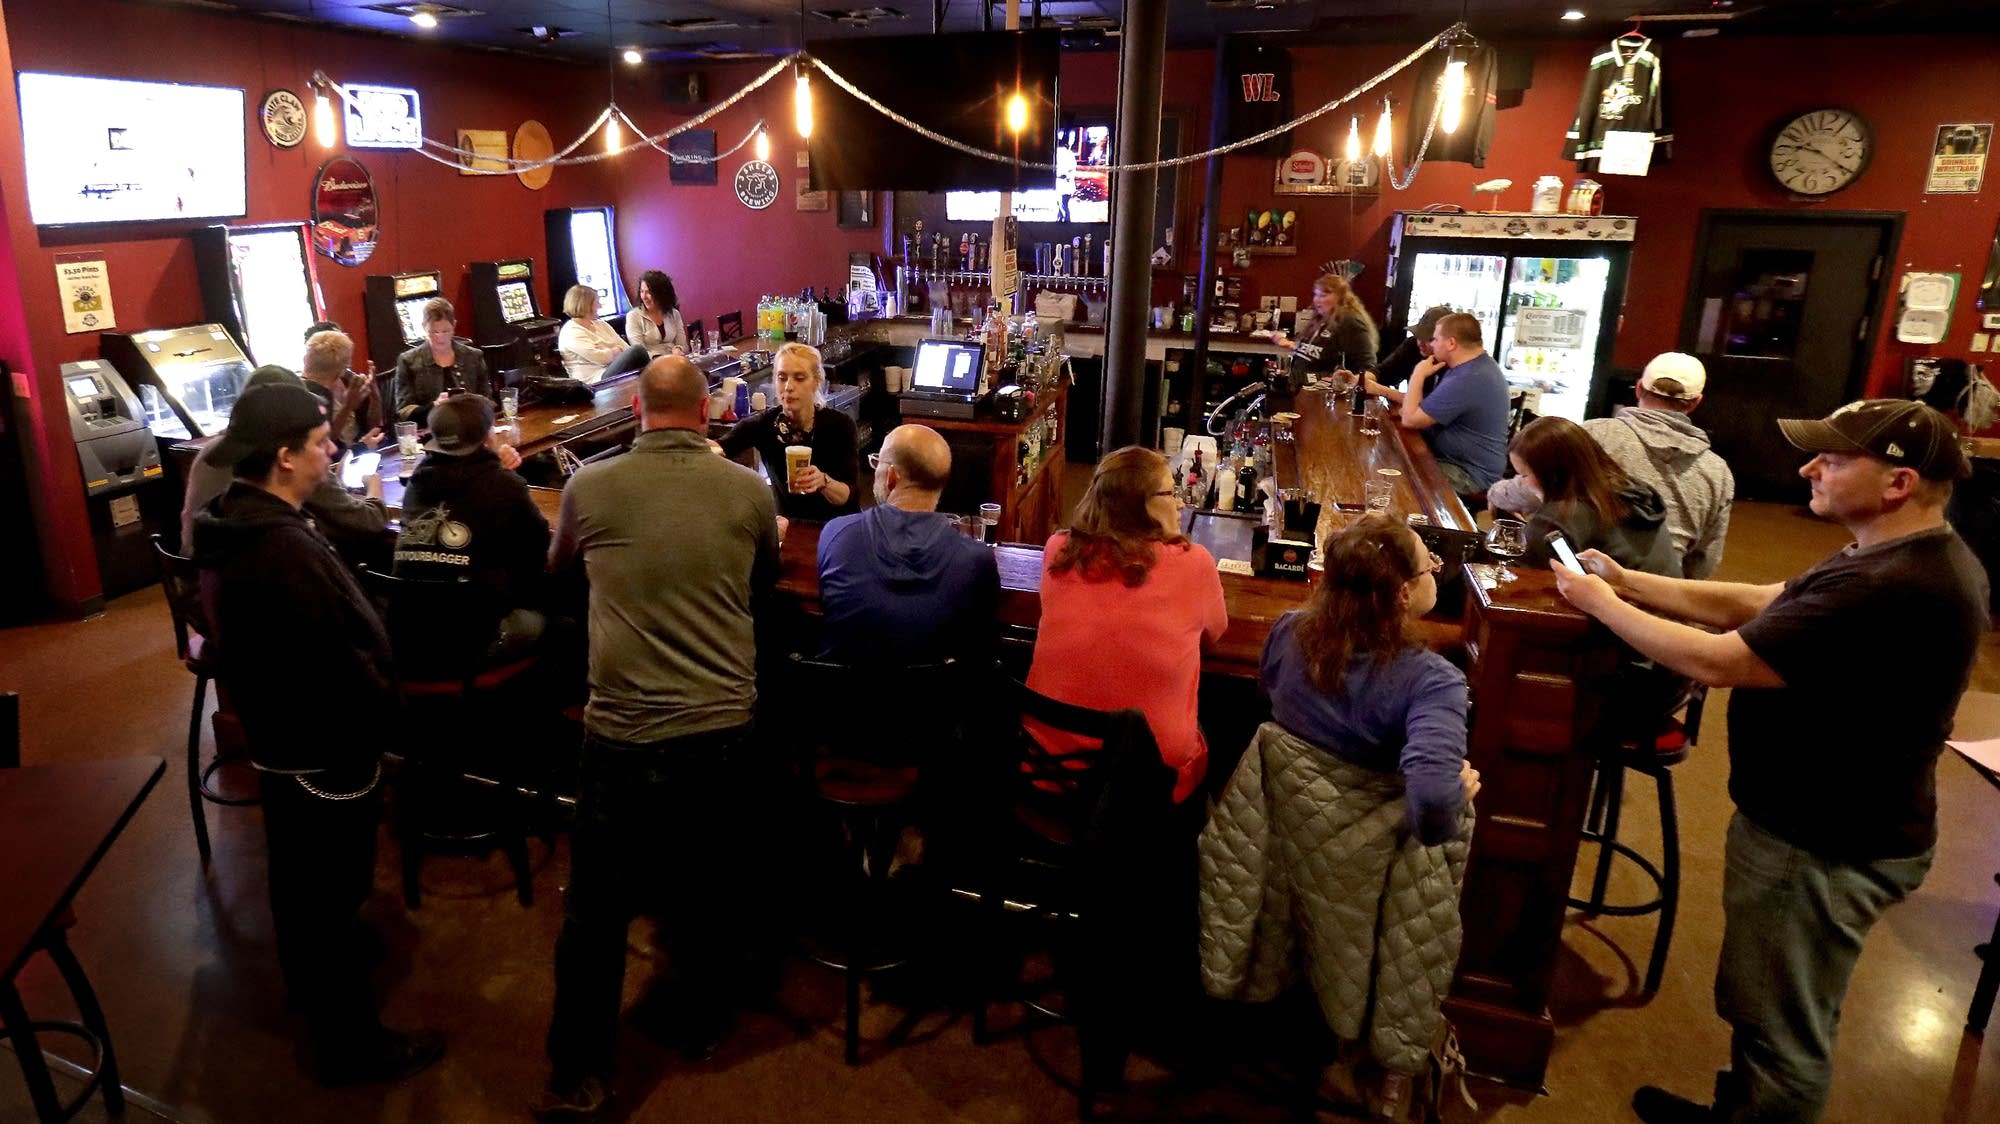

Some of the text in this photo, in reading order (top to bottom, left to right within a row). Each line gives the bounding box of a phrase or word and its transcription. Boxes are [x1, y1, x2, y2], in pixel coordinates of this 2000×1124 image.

[1818, 111, 1840, 131] 12
[743, 162, 775, 181] SHEEPS
[739, 190, 775, 206] BREWING
